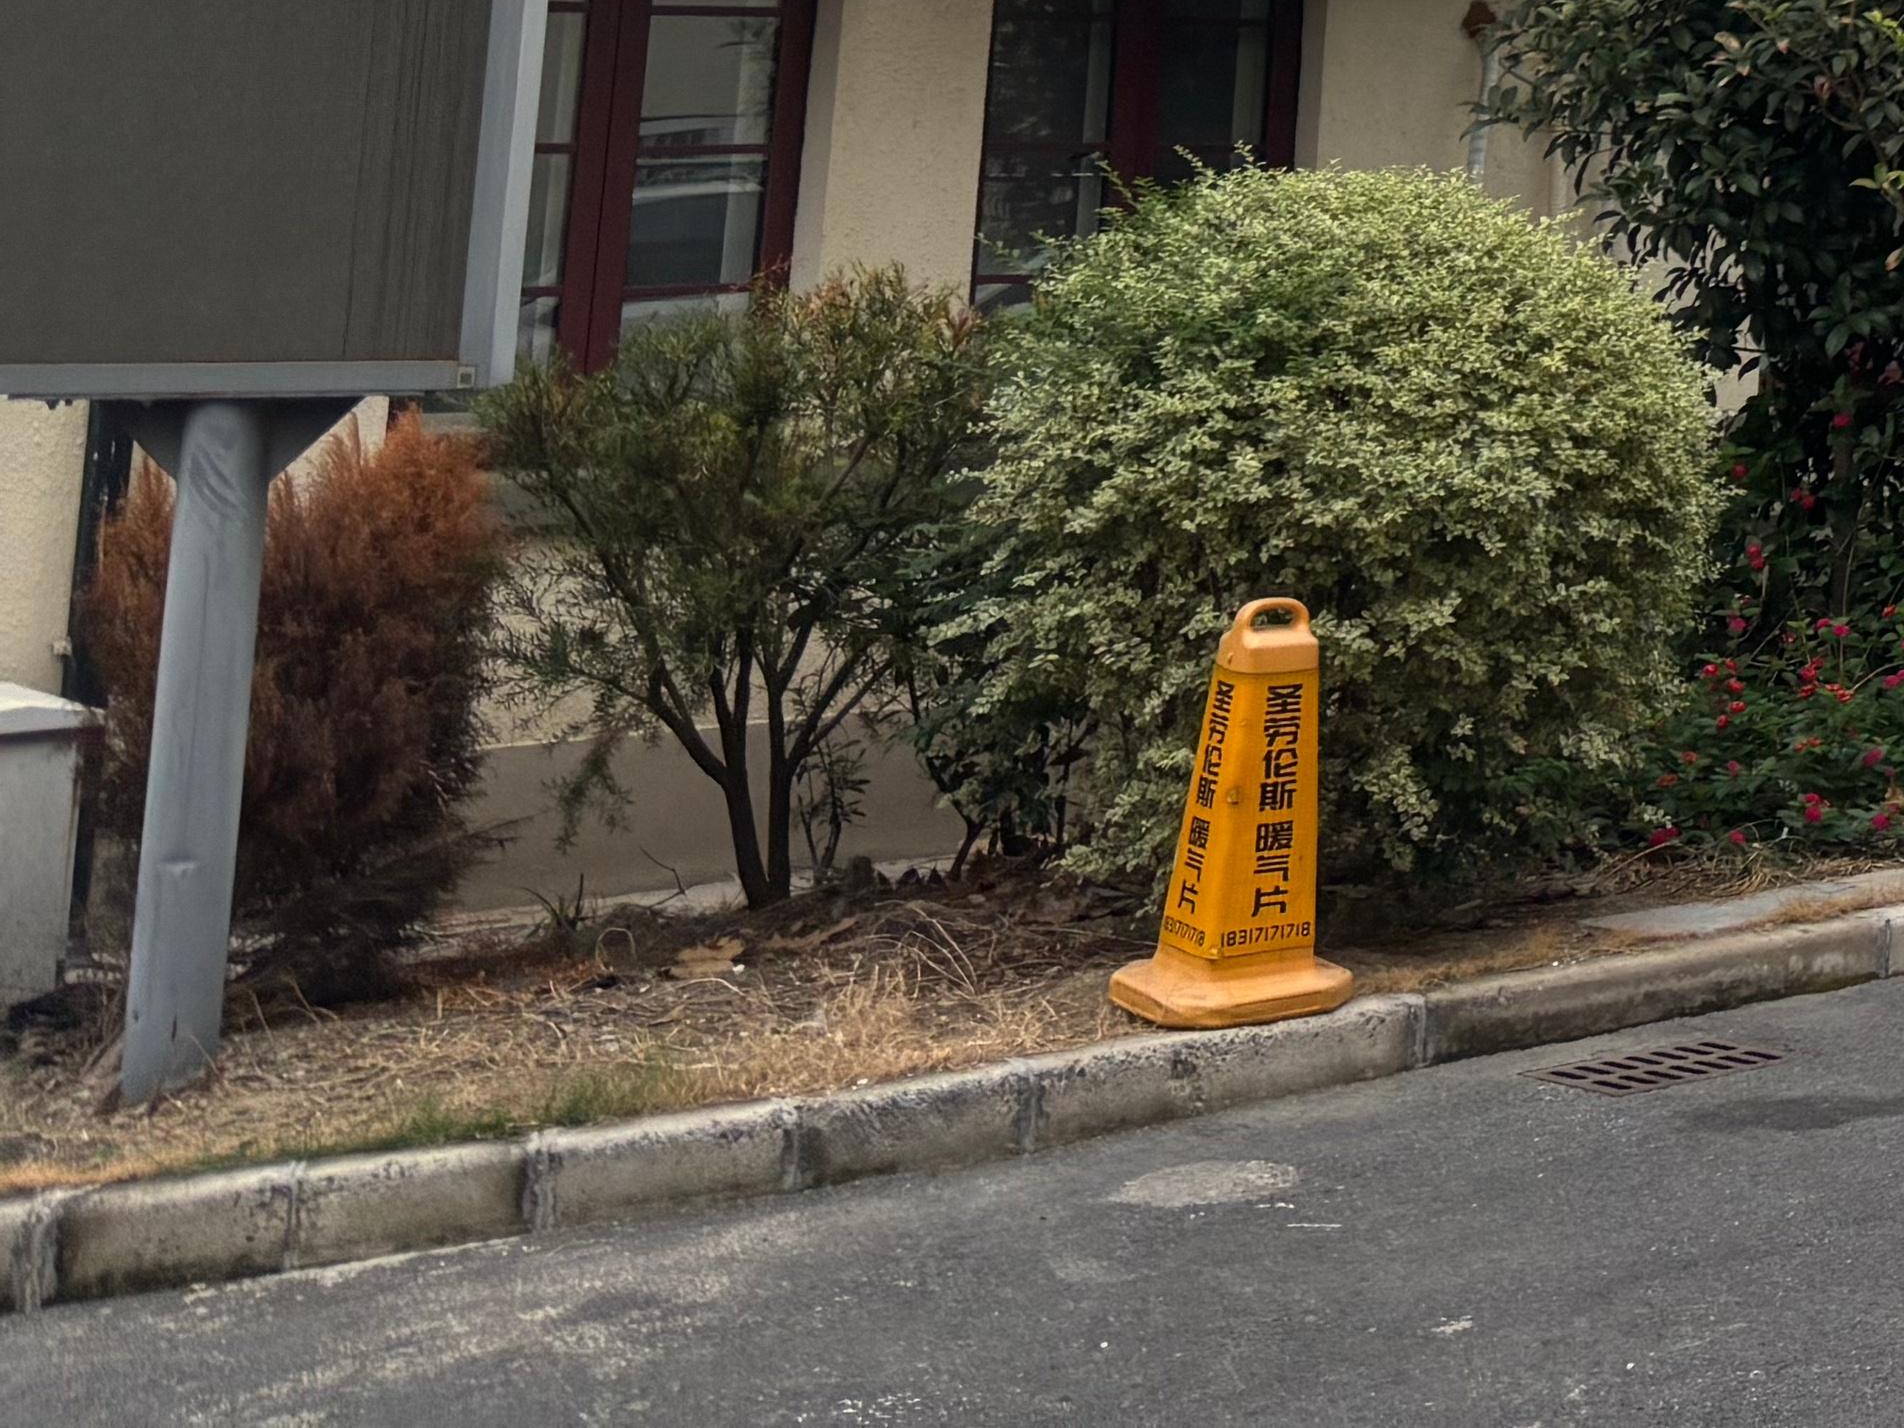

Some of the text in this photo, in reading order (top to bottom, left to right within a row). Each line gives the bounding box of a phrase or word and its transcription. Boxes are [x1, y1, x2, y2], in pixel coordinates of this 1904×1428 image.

[1251, 683, 1303, 917] 圣劳伦斯 暖气片
[1220, 921, 1312, 948] 18317171718
